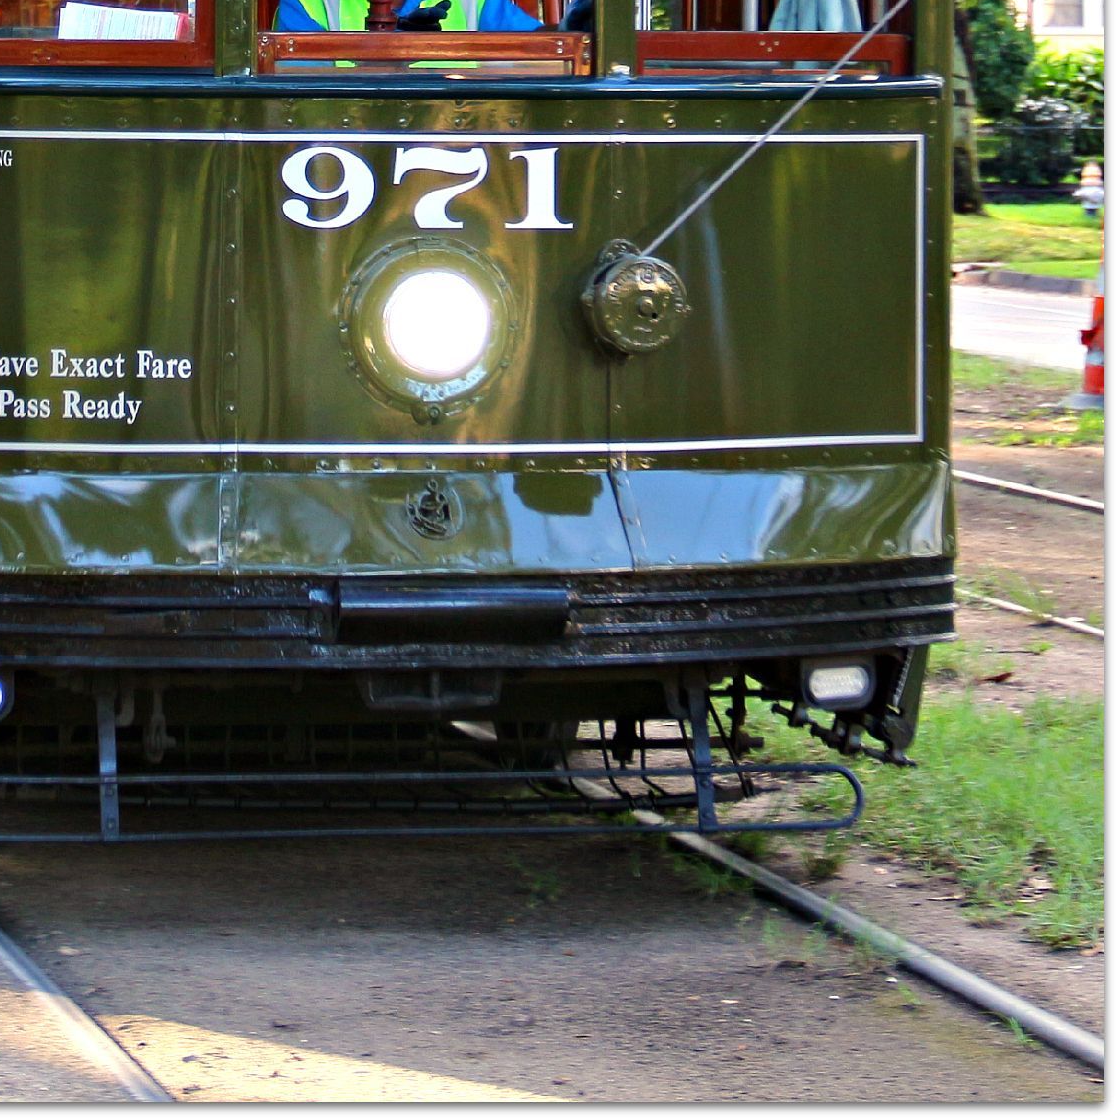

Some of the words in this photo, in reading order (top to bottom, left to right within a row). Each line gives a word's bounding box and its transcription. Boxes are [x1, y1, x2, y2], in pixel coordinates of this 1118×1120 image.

[281, 146, 574, 229] 971
[50, 349, 125, 378] Exact
[136, 350, 192, 379] Fare
[62, 390, 142, 424] Ready
